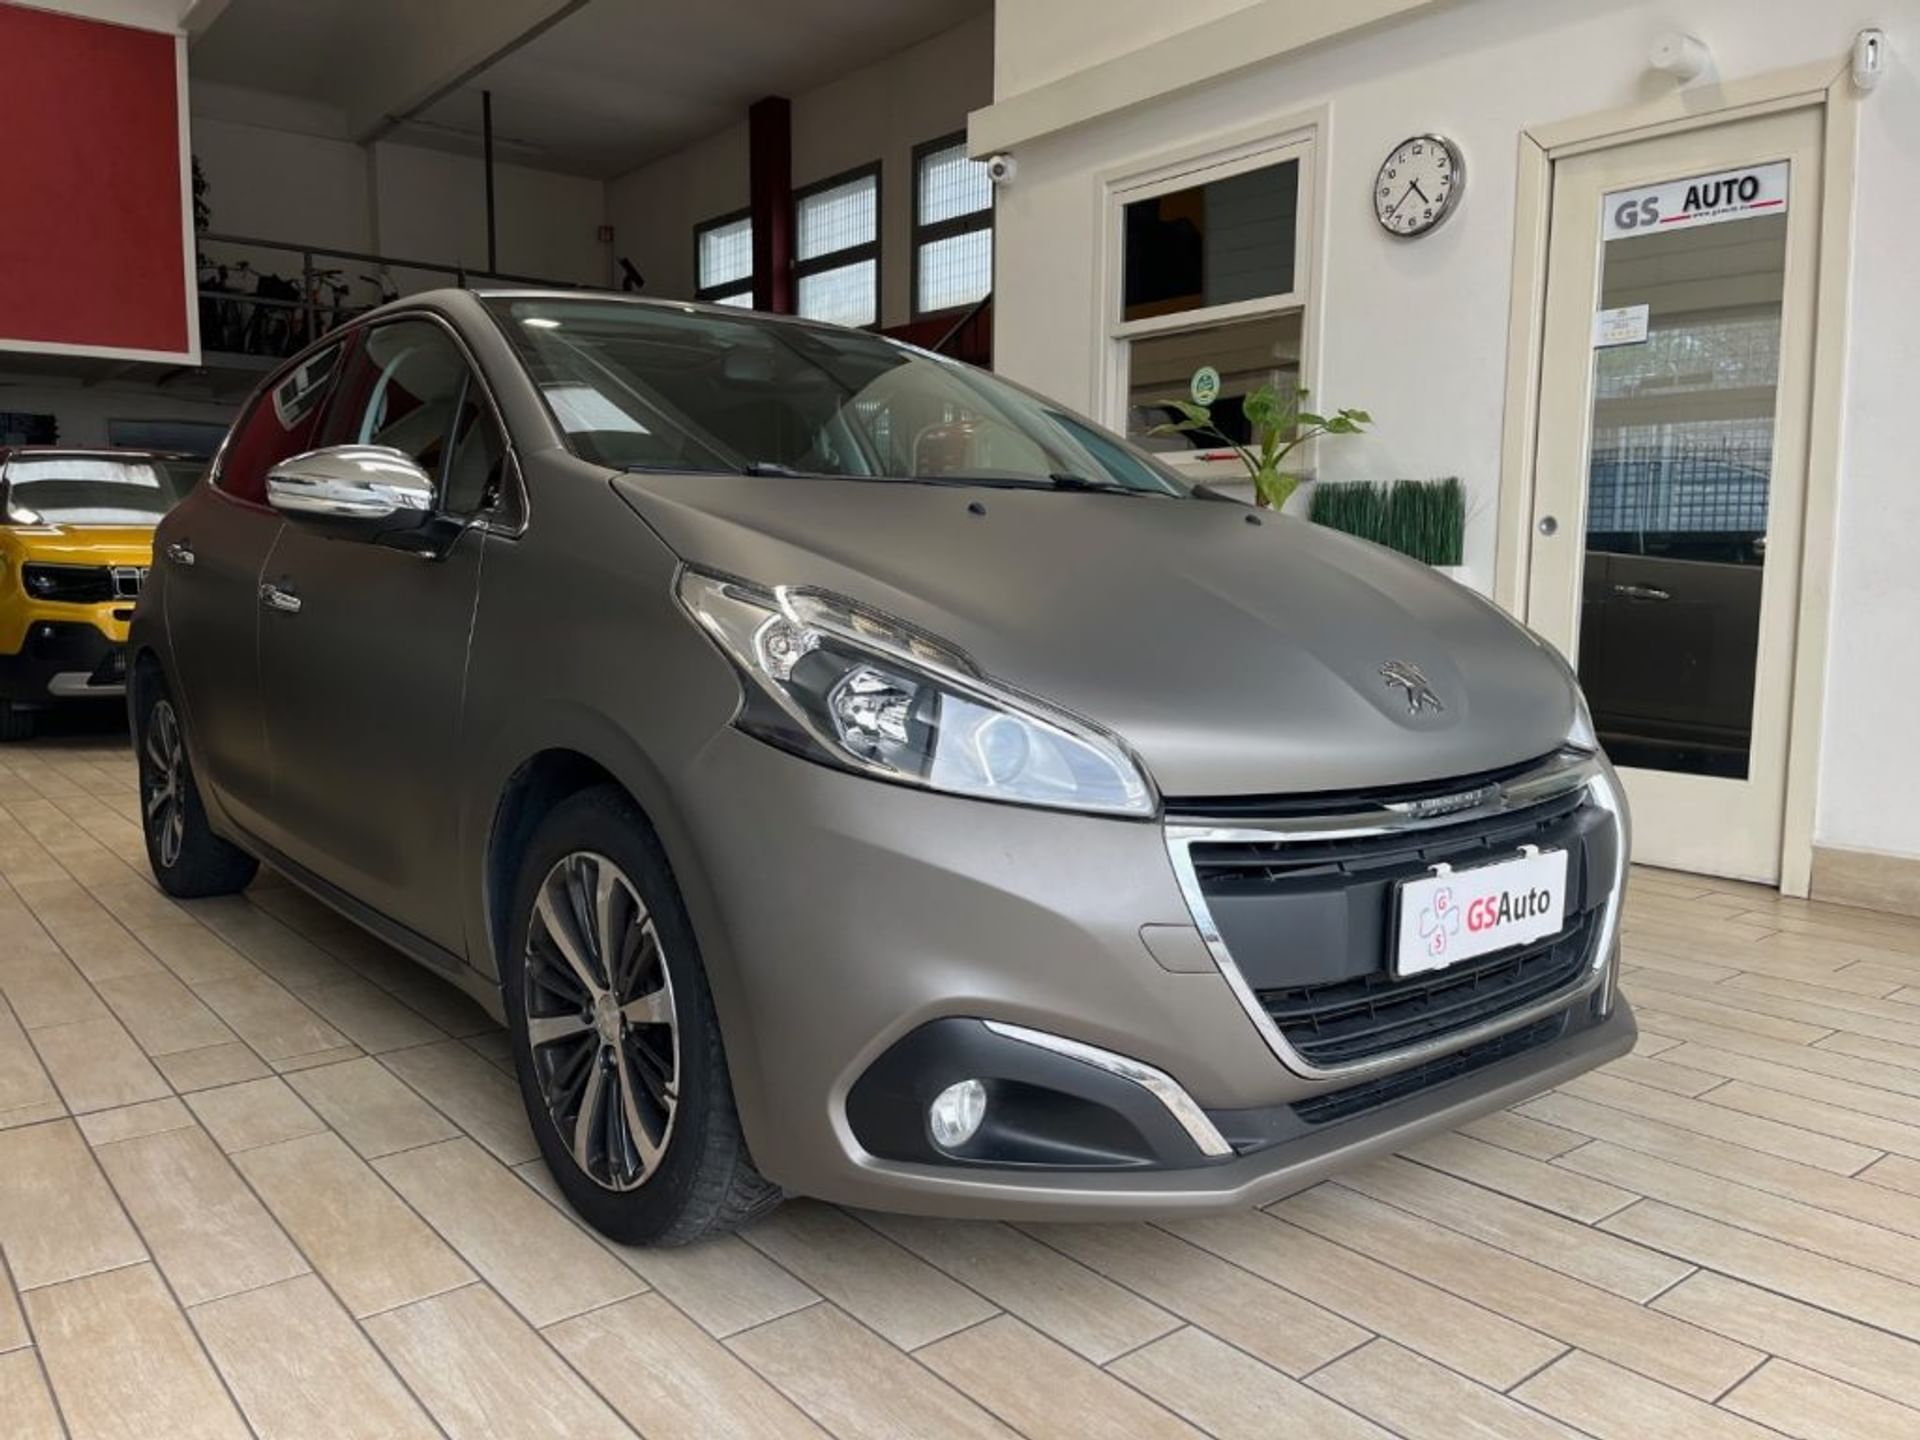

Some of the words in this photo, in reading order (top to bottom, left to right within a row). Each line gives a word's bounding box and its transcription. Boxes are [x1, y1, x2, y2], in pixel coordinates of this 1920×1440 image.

[1412, 145, 1422, 155] 12
[1437, 157, 1446, 168] 2
[1441, 174, 1449, 185] 3
[1382, 187, 1390, 196] 9
[1435, 193, 1443, 203] 4
[1614, 196, 1660, 229] GS
[1683, 176, 1759, 212] AUTO
[1423, 208, 1432, 219] 5
[1395, 214, 1404, 225] 7
[1408, 216, 1416, 226] 6
[1438, 895, 1447, 910] G
[1467, 887, 1550, 931] GSAuto
[1434, 936, 1441, 949] S
